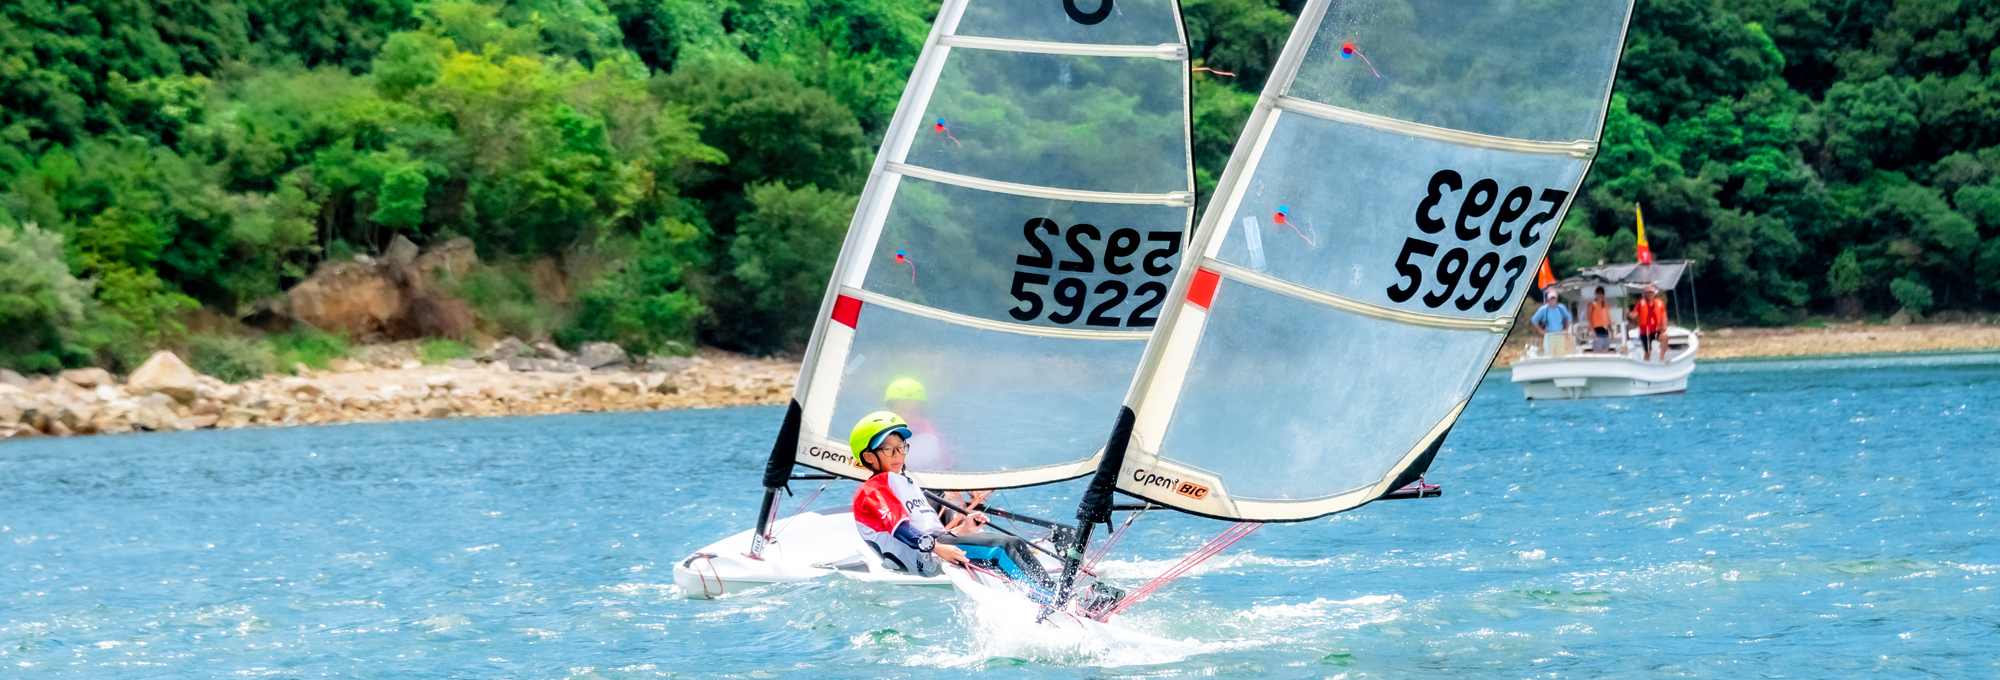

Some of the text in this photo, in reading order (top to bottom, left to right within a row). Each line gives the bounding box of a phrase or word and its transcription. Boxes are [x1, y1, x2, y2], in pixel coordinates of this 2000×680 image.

[1009, 271, 1167, 327] 5922
[1387, 237, 1527, 312] 5993
[1179, 484, 1206, 497] BIC
